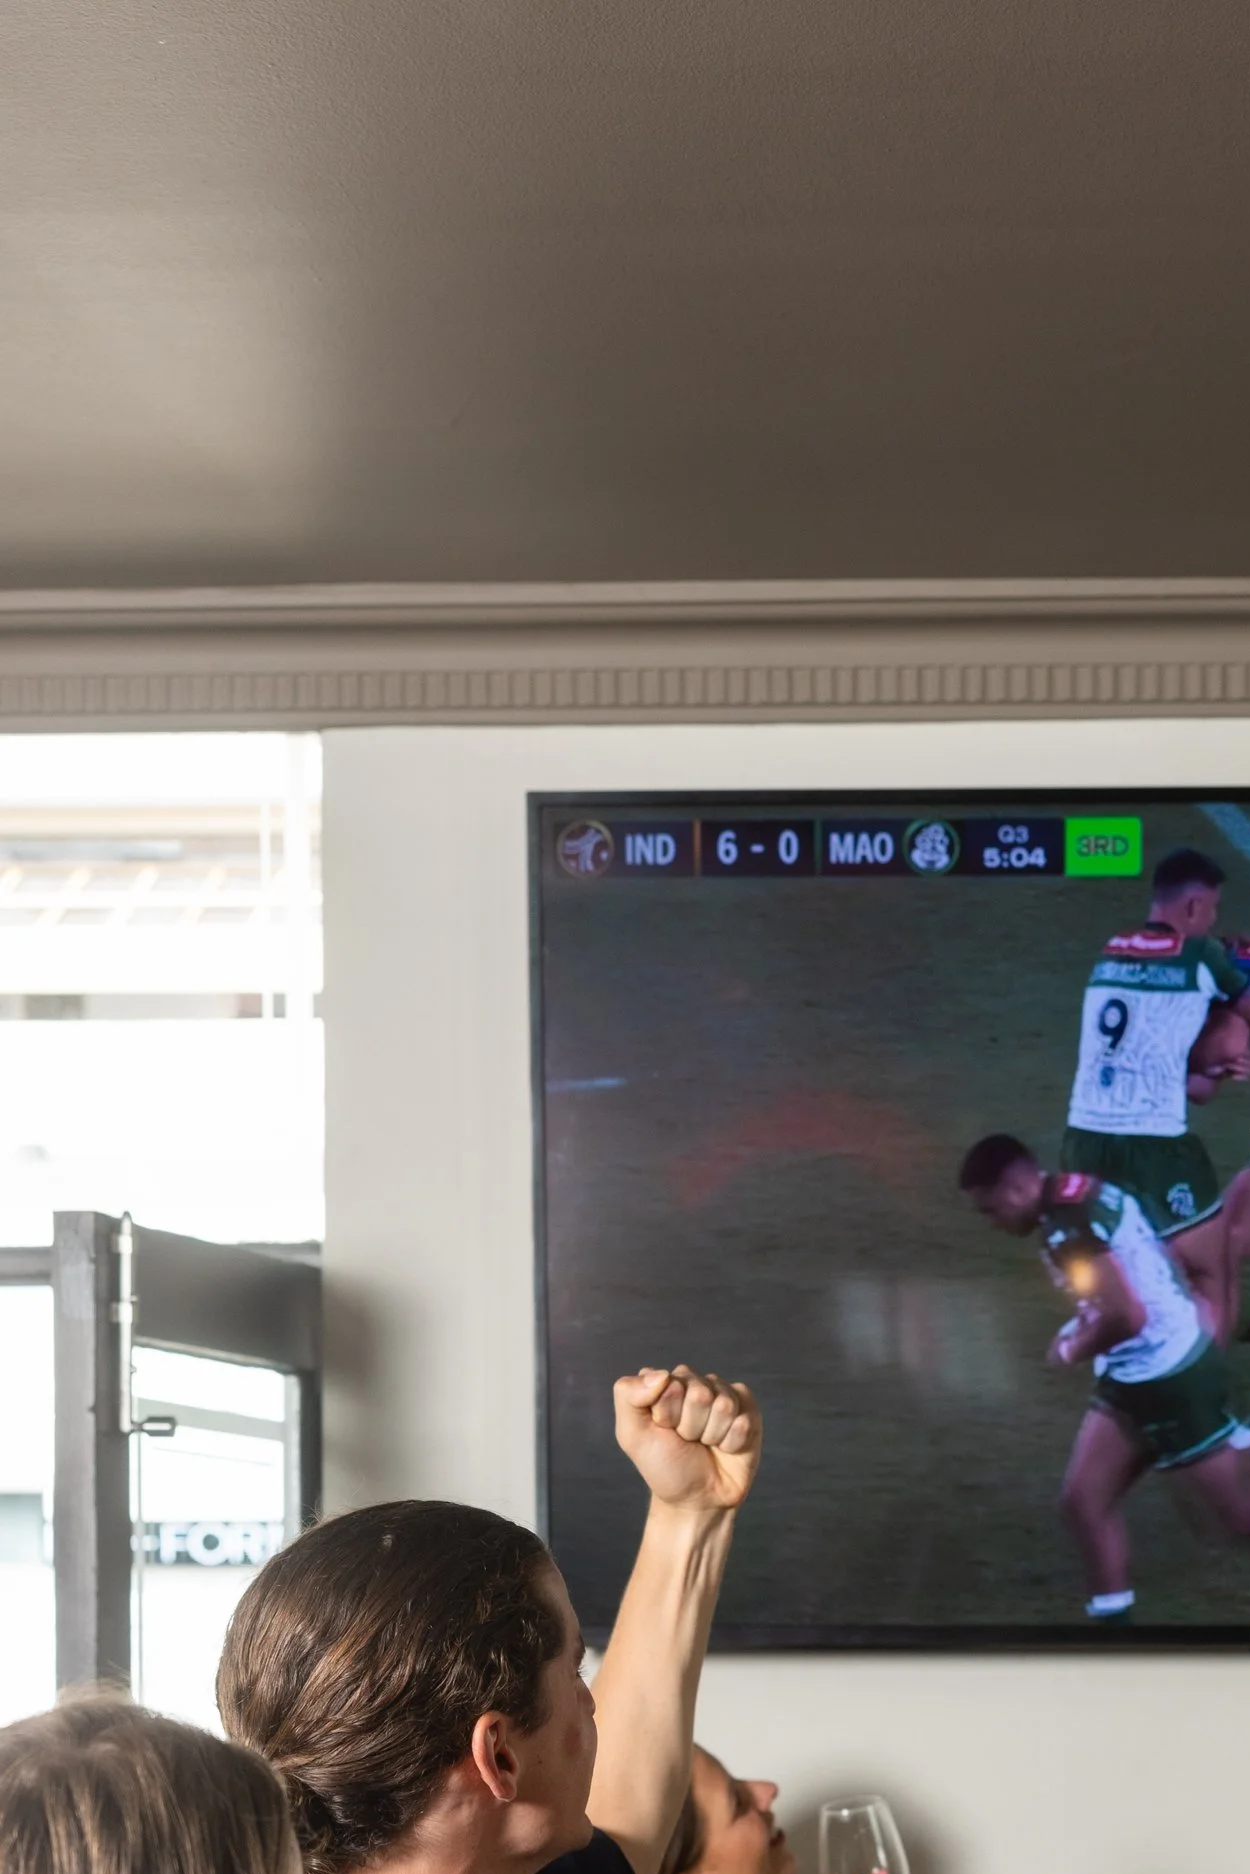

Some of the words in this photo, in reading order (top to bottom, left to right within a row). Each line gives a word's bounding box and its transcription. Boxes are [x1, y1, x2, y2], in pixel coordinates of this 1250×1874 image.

[625, 833, 676, 865] IND
[716, 830, 738, 865] 6
[777, 829, 799, 865] 0
[829, 832, 894, 864] MAO
[982, 847, 1047, 868] 5:04
[1098, 999, 1128, 1050] 9
